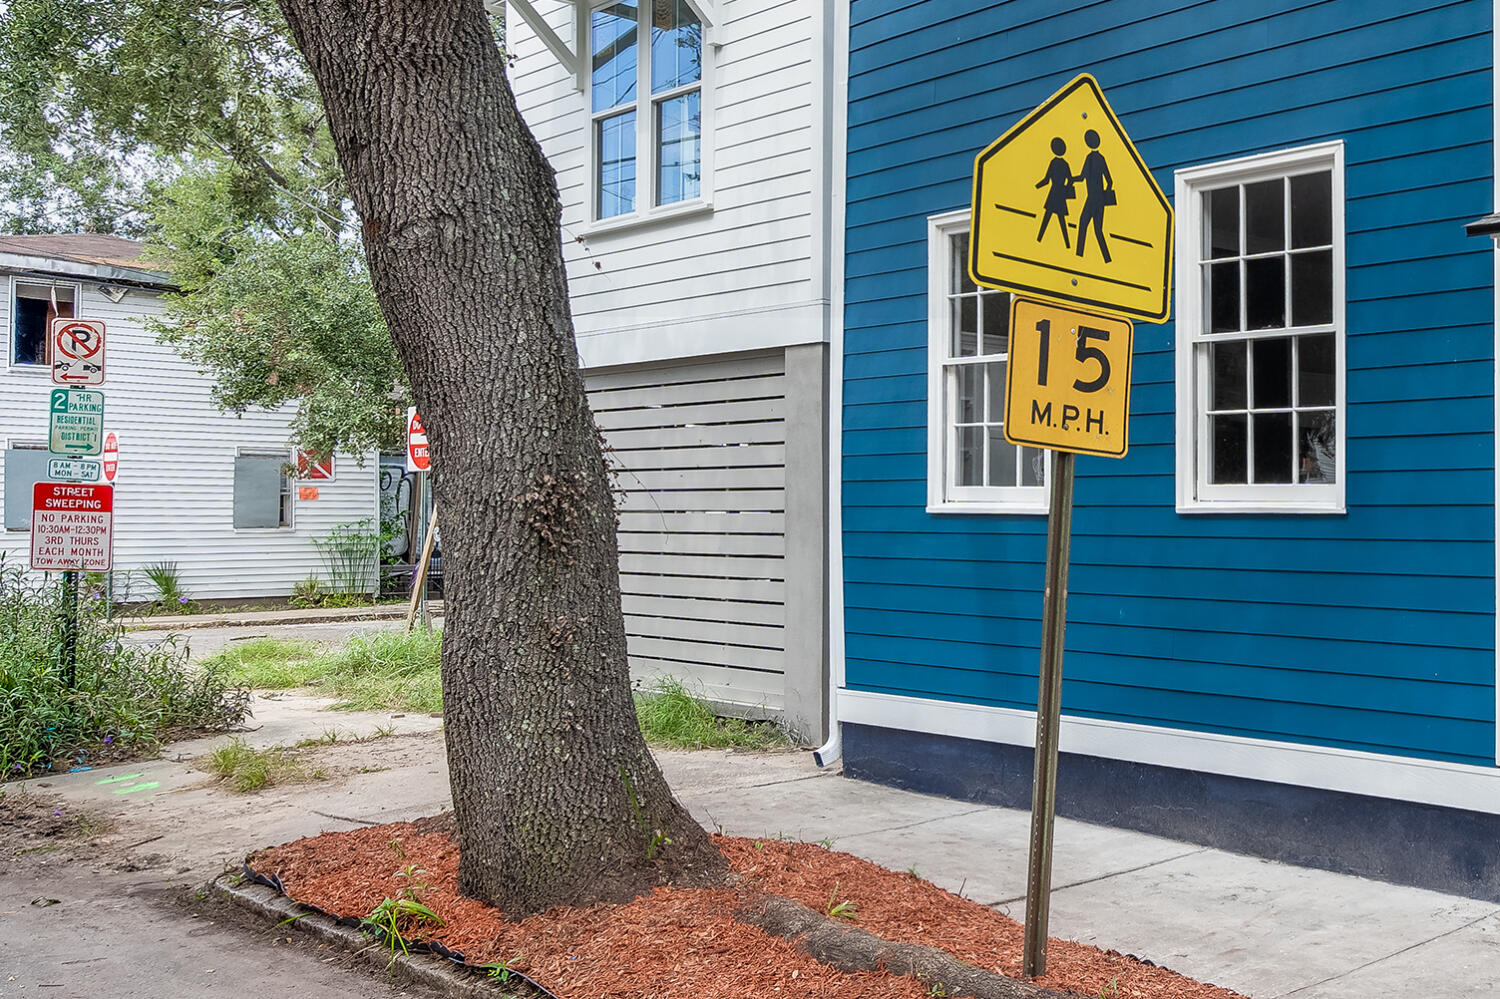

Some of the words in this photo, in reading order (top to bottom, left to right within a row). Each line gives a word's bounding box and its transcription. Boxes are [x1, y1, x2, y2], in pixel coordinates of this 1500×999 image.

[1035, 318, 1112, 394] 15
[54, 392, 66, 409] 2
[78, 394, 92, 402] HR
[69, 402, 102, 412] PARKING
[57, 415, 96, 425] RESIDENTIAL
[1030, 399, 1110, 436] M.P.H.
[61, 432, 90, 441] DISTRICT
[414, 447, 430, 458] ENTE
[53, 486, 95, 497] STREET
[45, 498, 102, 509] SWEEPING
[41, 513, 55, 523] NO
[61, 514, 104, 524] PARKING
[38, 524, 107, 535] 10:30AM-12:30PM
[44, 536, 64, 545] 3RD
[70, 536, 99, 546] THURS
[38, 547, 65, 556] EACH
[71, 547, 104, 557] MONTH
[84, 558, 106, 566] ZONE
